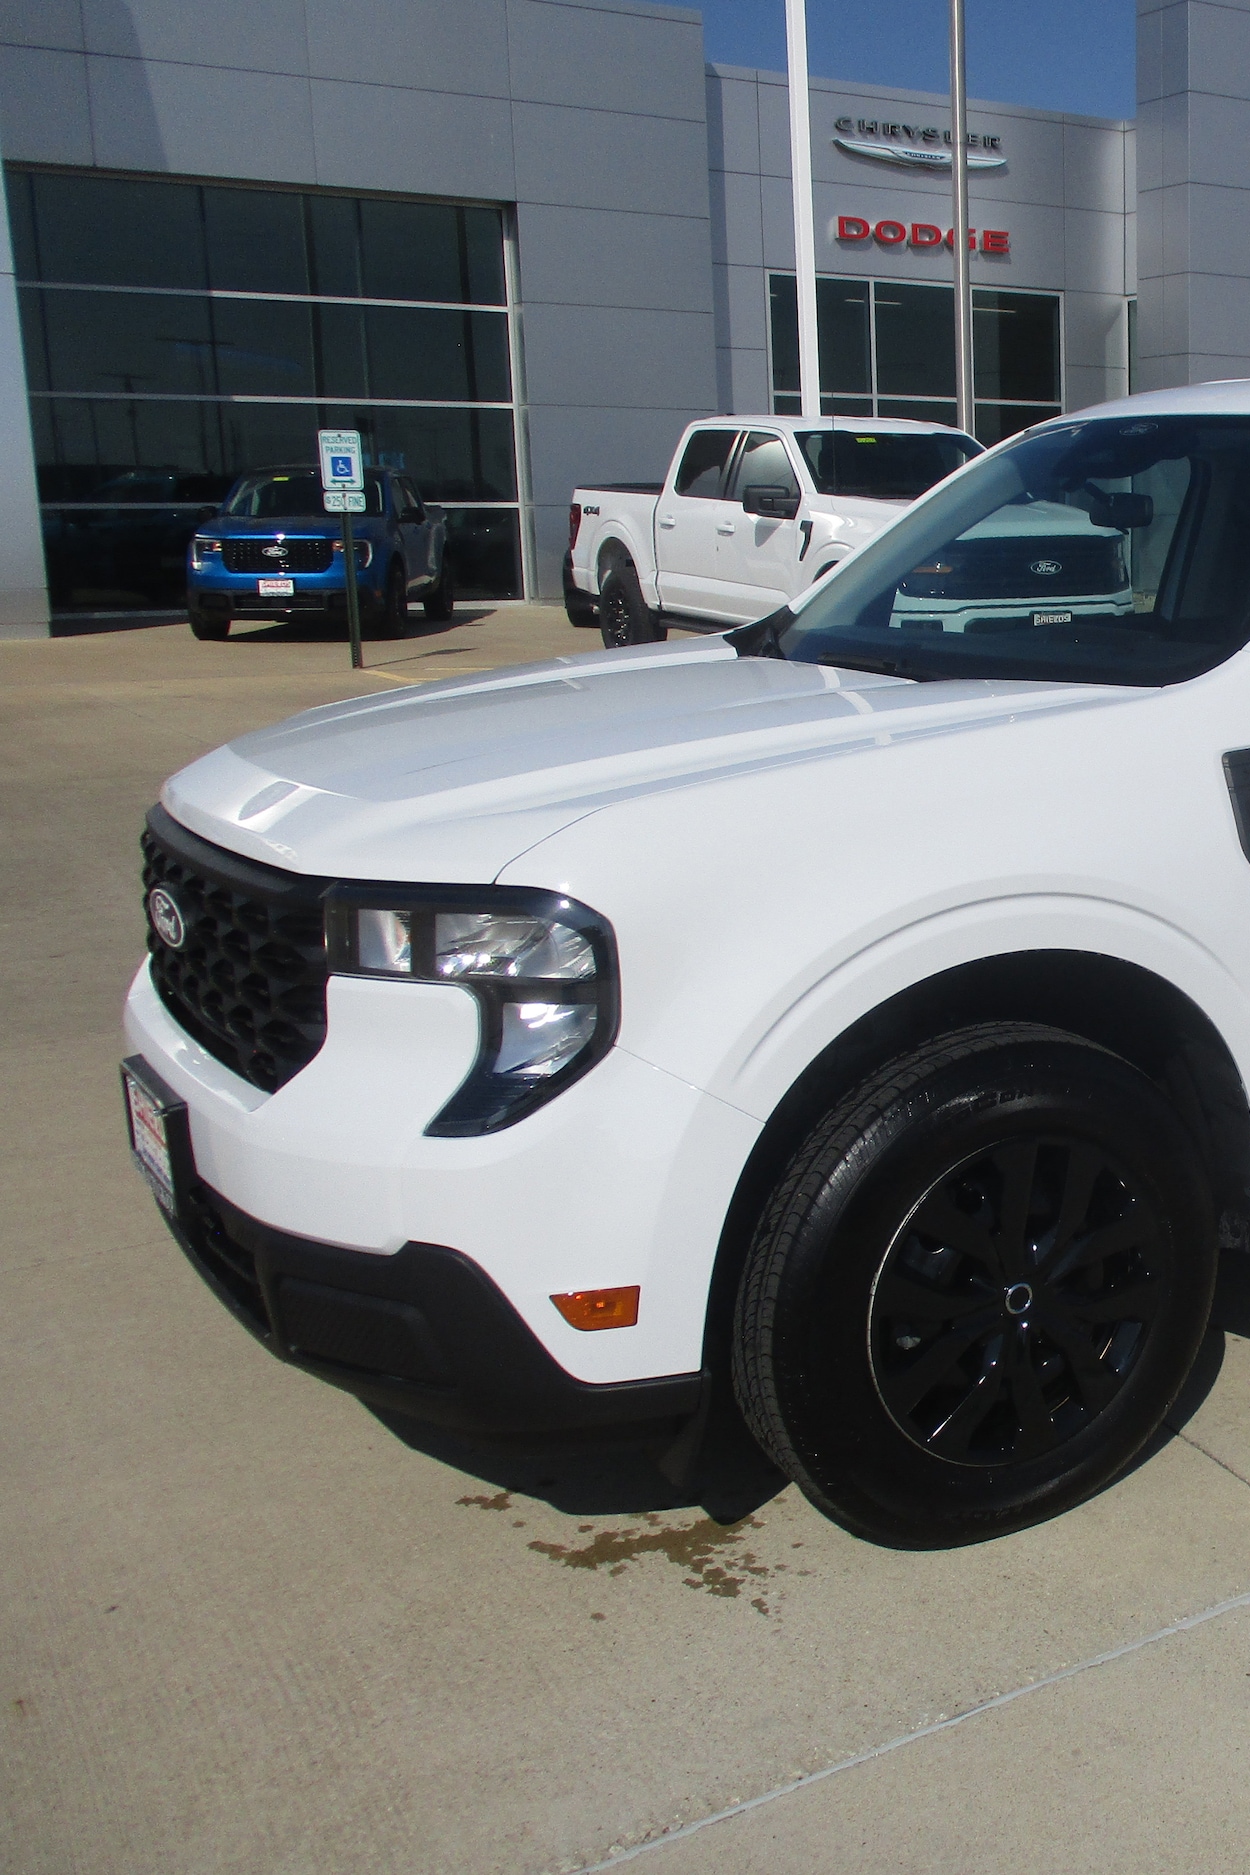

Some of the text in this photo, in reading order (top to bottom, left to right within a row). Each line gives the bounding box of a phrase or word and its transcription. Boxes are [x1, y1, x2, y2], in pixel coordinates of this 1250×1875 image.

[835, 117, 1001, 149] CHRYSLER
[322, 435, 358, 444] RESERVED
[325, 446, 356, 454] PARKING
[1035, 562, 1058, 573] Ford
[154, 893, 177, 941] Ford
